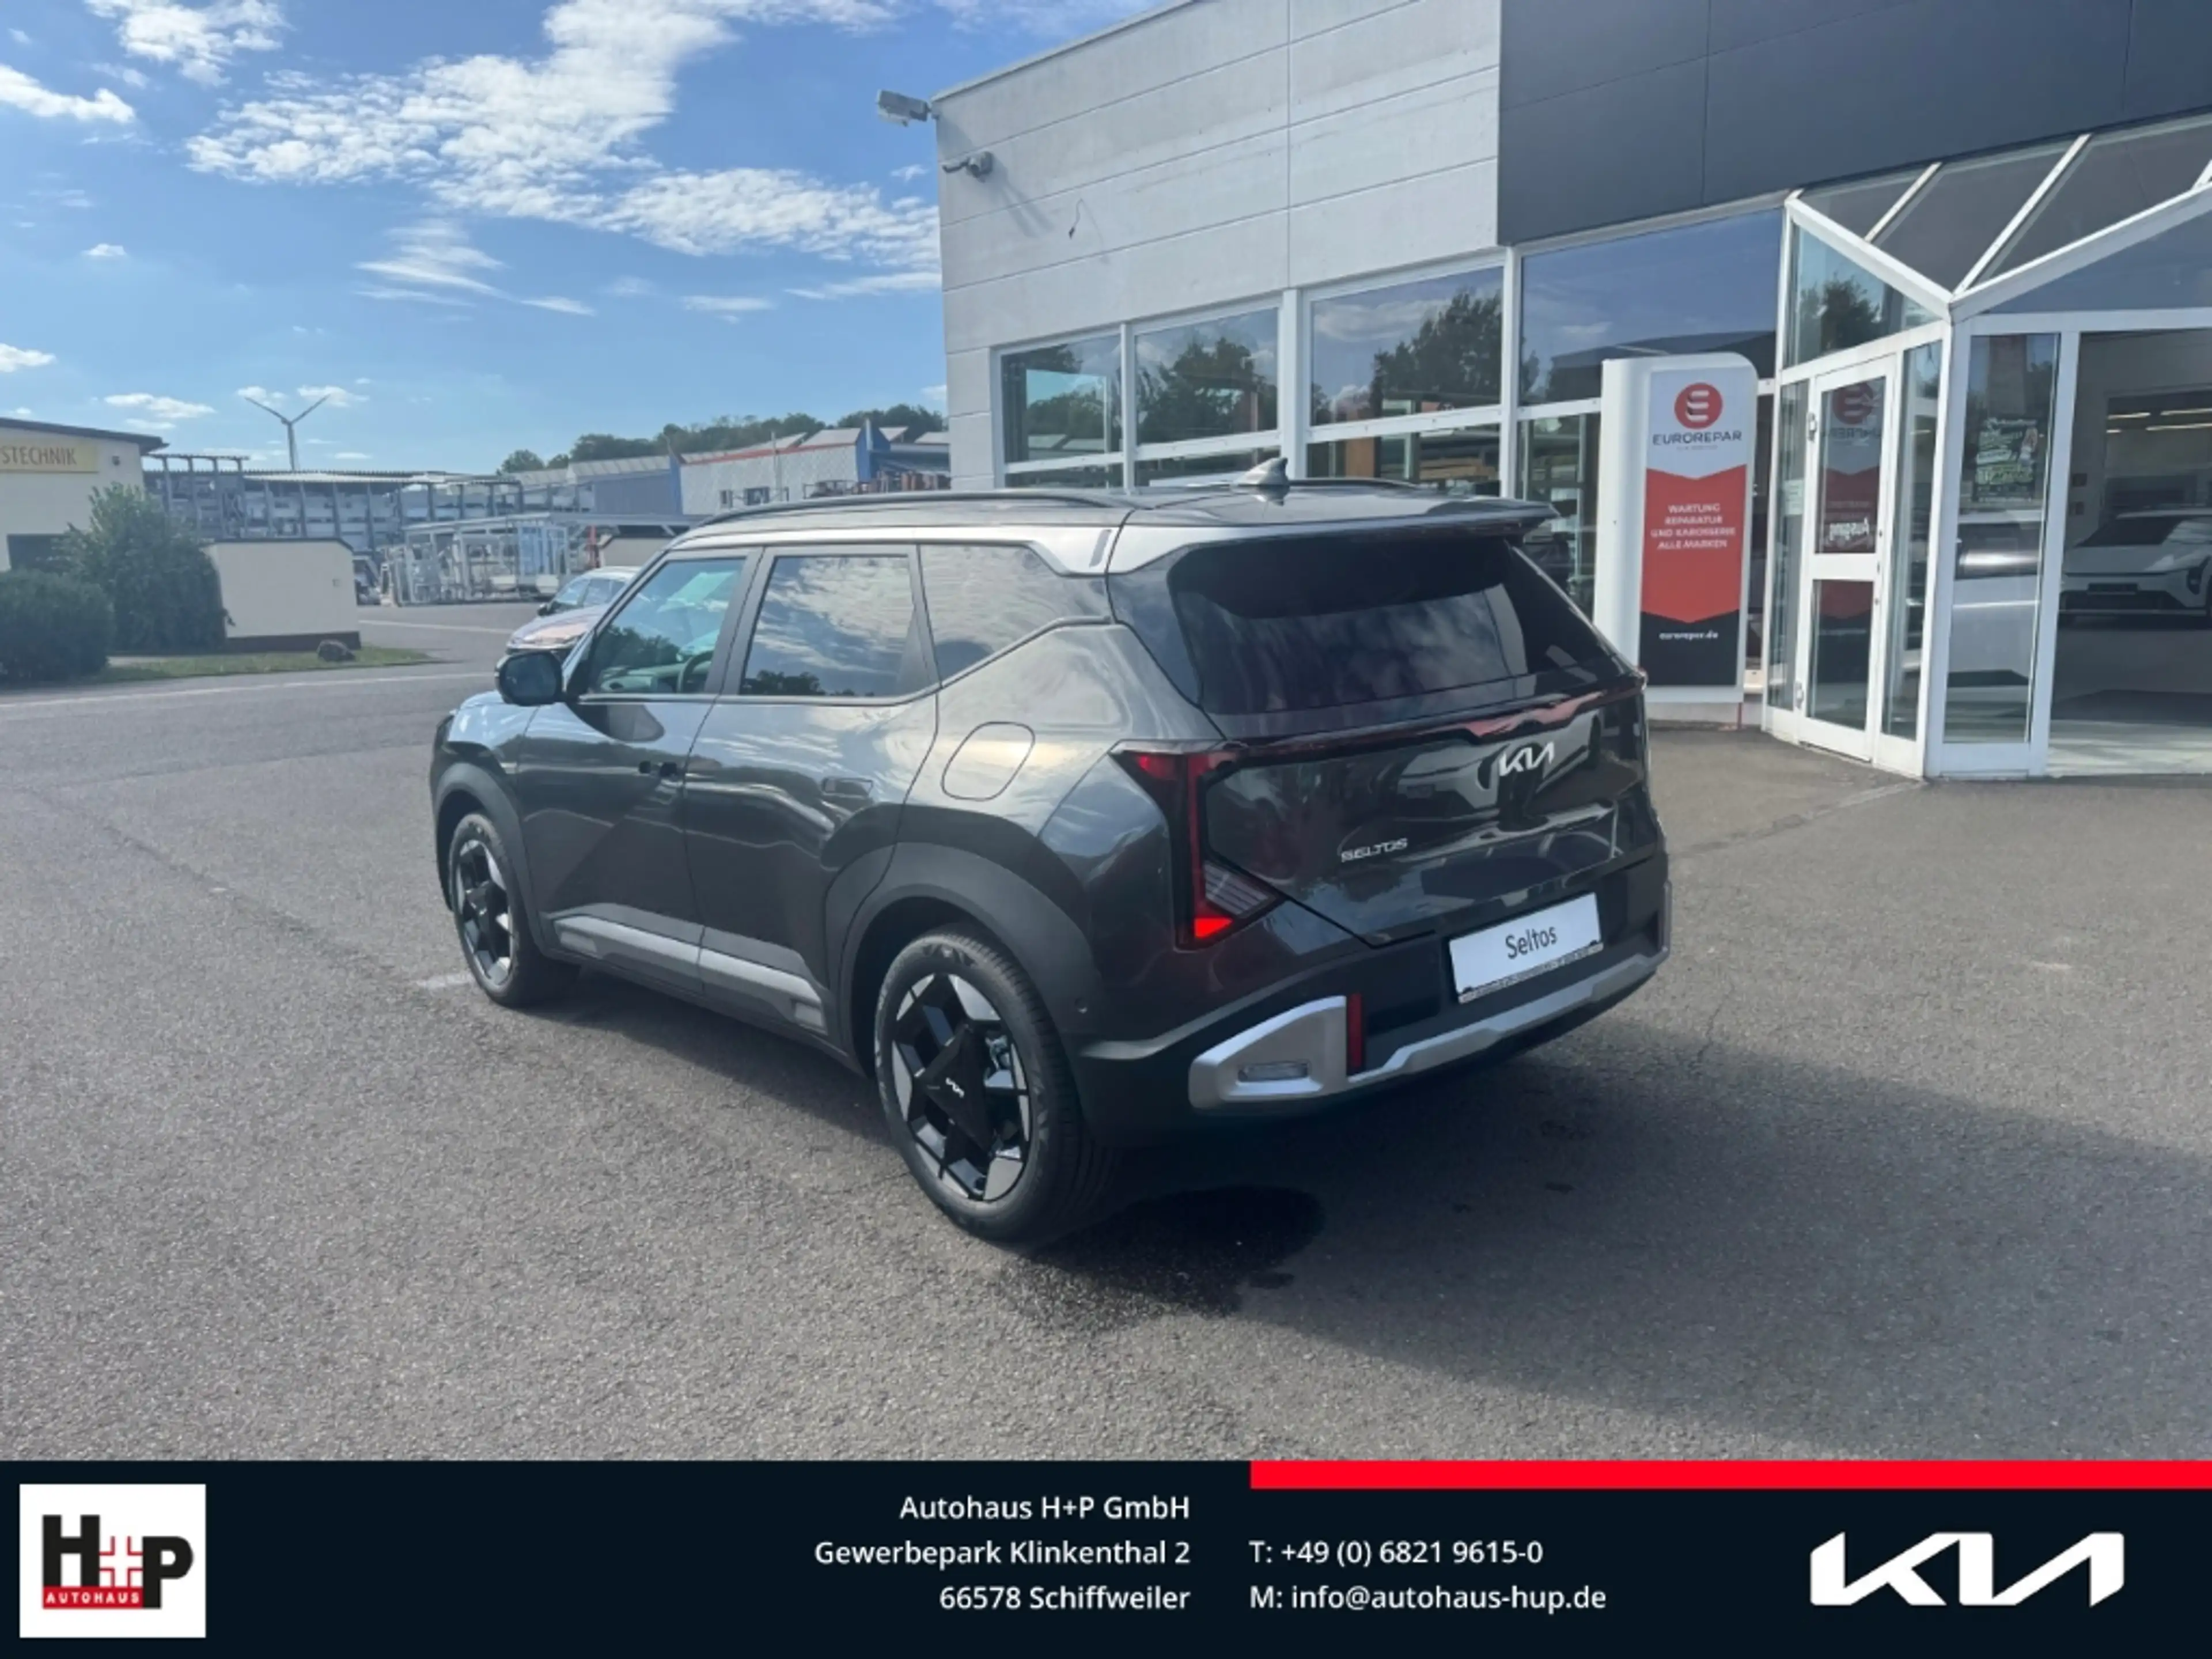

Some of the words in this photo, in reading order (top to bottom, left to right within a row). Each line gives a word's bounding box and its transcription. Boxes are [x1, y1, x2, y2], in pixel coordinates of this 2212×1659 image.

[1652, 431, 1743, 445] EUROREPAR
[1668, 503, 1721, 513] WARTUNG
[1665, 515, 1723, 525] REPARATUR
[1657, 540, 1681, 550] ALLE
[1683, 539, 1728, 548] MARKEN
[1341, 838, 1408, 862] SELTOS
[1505, 926, 1558, 960] Seltos
